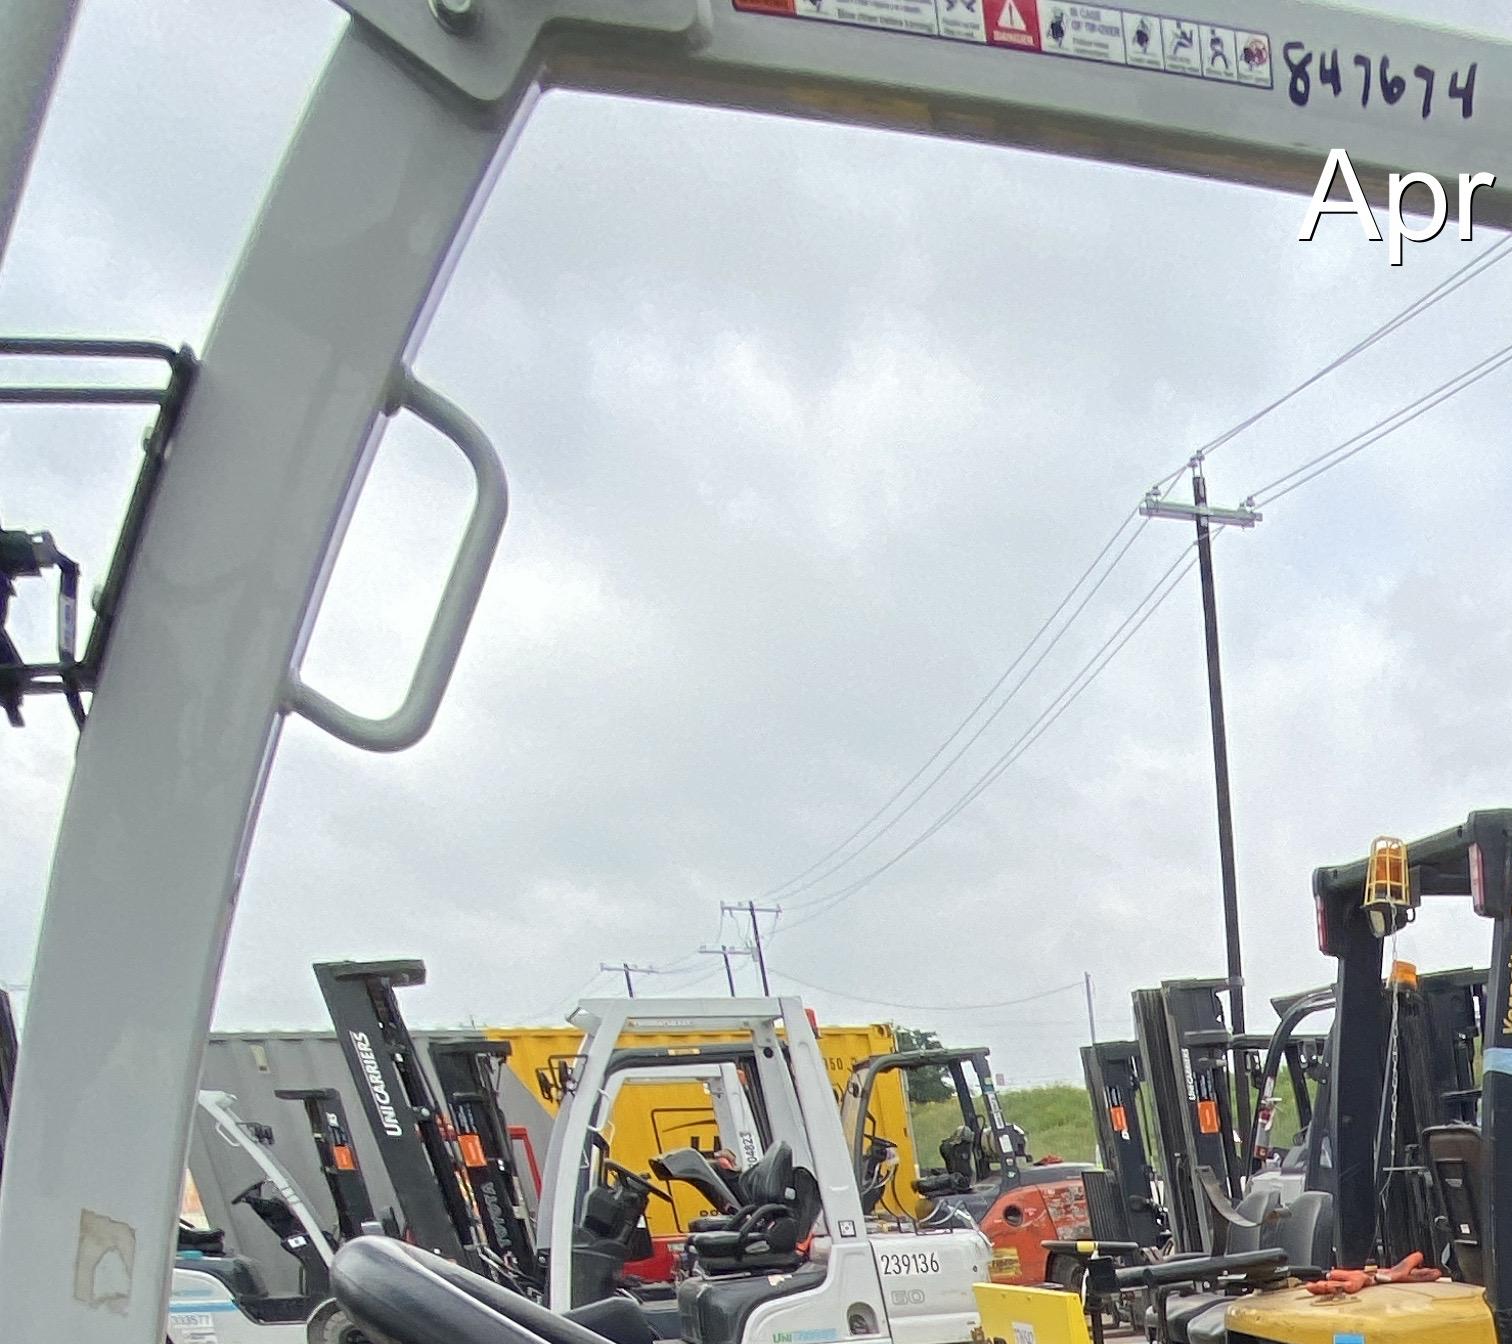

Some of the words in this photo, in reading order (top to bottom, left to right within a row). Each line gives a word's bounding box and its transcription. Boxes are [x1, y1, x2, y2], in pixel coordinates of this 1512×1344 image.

[1283, 40, 1478, 120] 847674
[349, 1030, 403, 1137] UNICARRIERS
[739, 1131, 759, 1168] 04823
[880, 1251, 940, 1276] 239136
